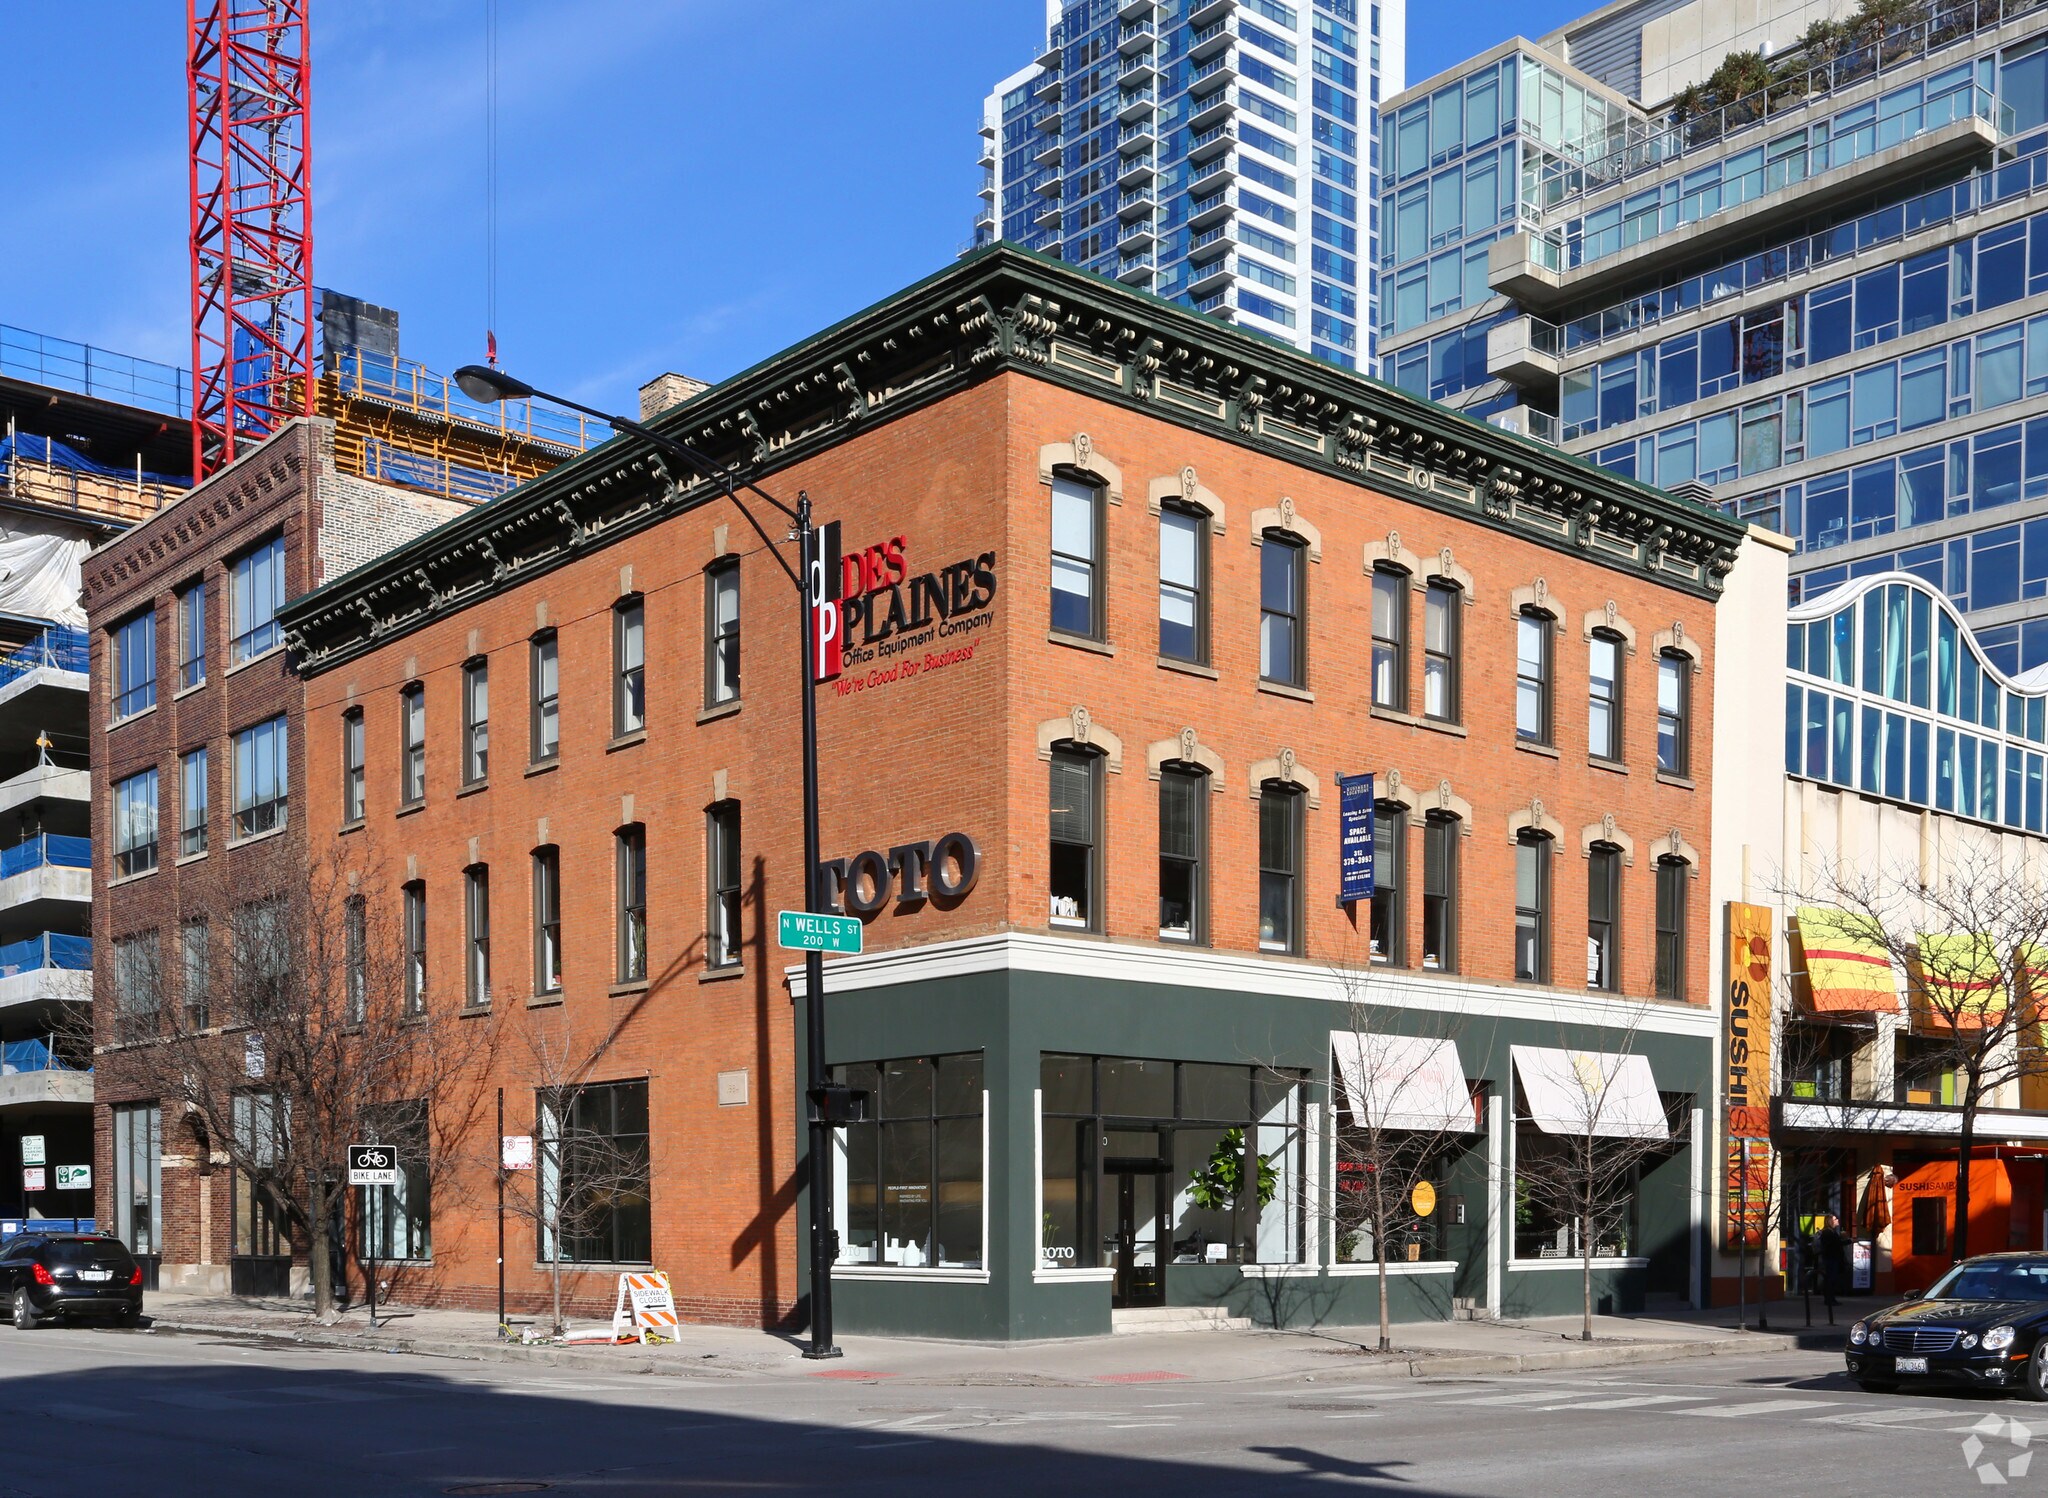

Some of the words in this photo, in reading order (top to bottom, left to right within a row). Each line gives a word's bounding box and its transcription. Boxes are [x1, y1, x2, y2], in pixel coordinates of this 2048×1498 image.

[841, 535, 907, 600] DES
[840, 551, 997, 652] PLAINES
[843, 648, 874, 668] Office
[878, 627, 934, 658] Equipment
[938, 611, 994, 638] Company
[867, 662, 898, 689] Good
[901, 659, 920, 680] For
[1349, 826, 1367, 836] SPACE
[1343, 834, 1372, 845] AVAILABLE
[1353, 849, 1363, 857] 312
[1343, 855, 1372, 866] 379-3993
[819, 832, 982, 913] TOTO
[783, 919, 790, 929] N
[795, 917, 841, 935] WELLS
[847, 925, 858, 935] ST
[803, 935, 824, 946] 200
[832, 937, 840, 947] W
[353, 1171, 370, 1180] BIKE
[373, 1172, 392, 1180] LANE
[1042, 1247, 1075, 1259] TOTO
[633, 1289, 669, 1298] SIDEWALK
[639, 1296, 667, 1304] CLOSED
